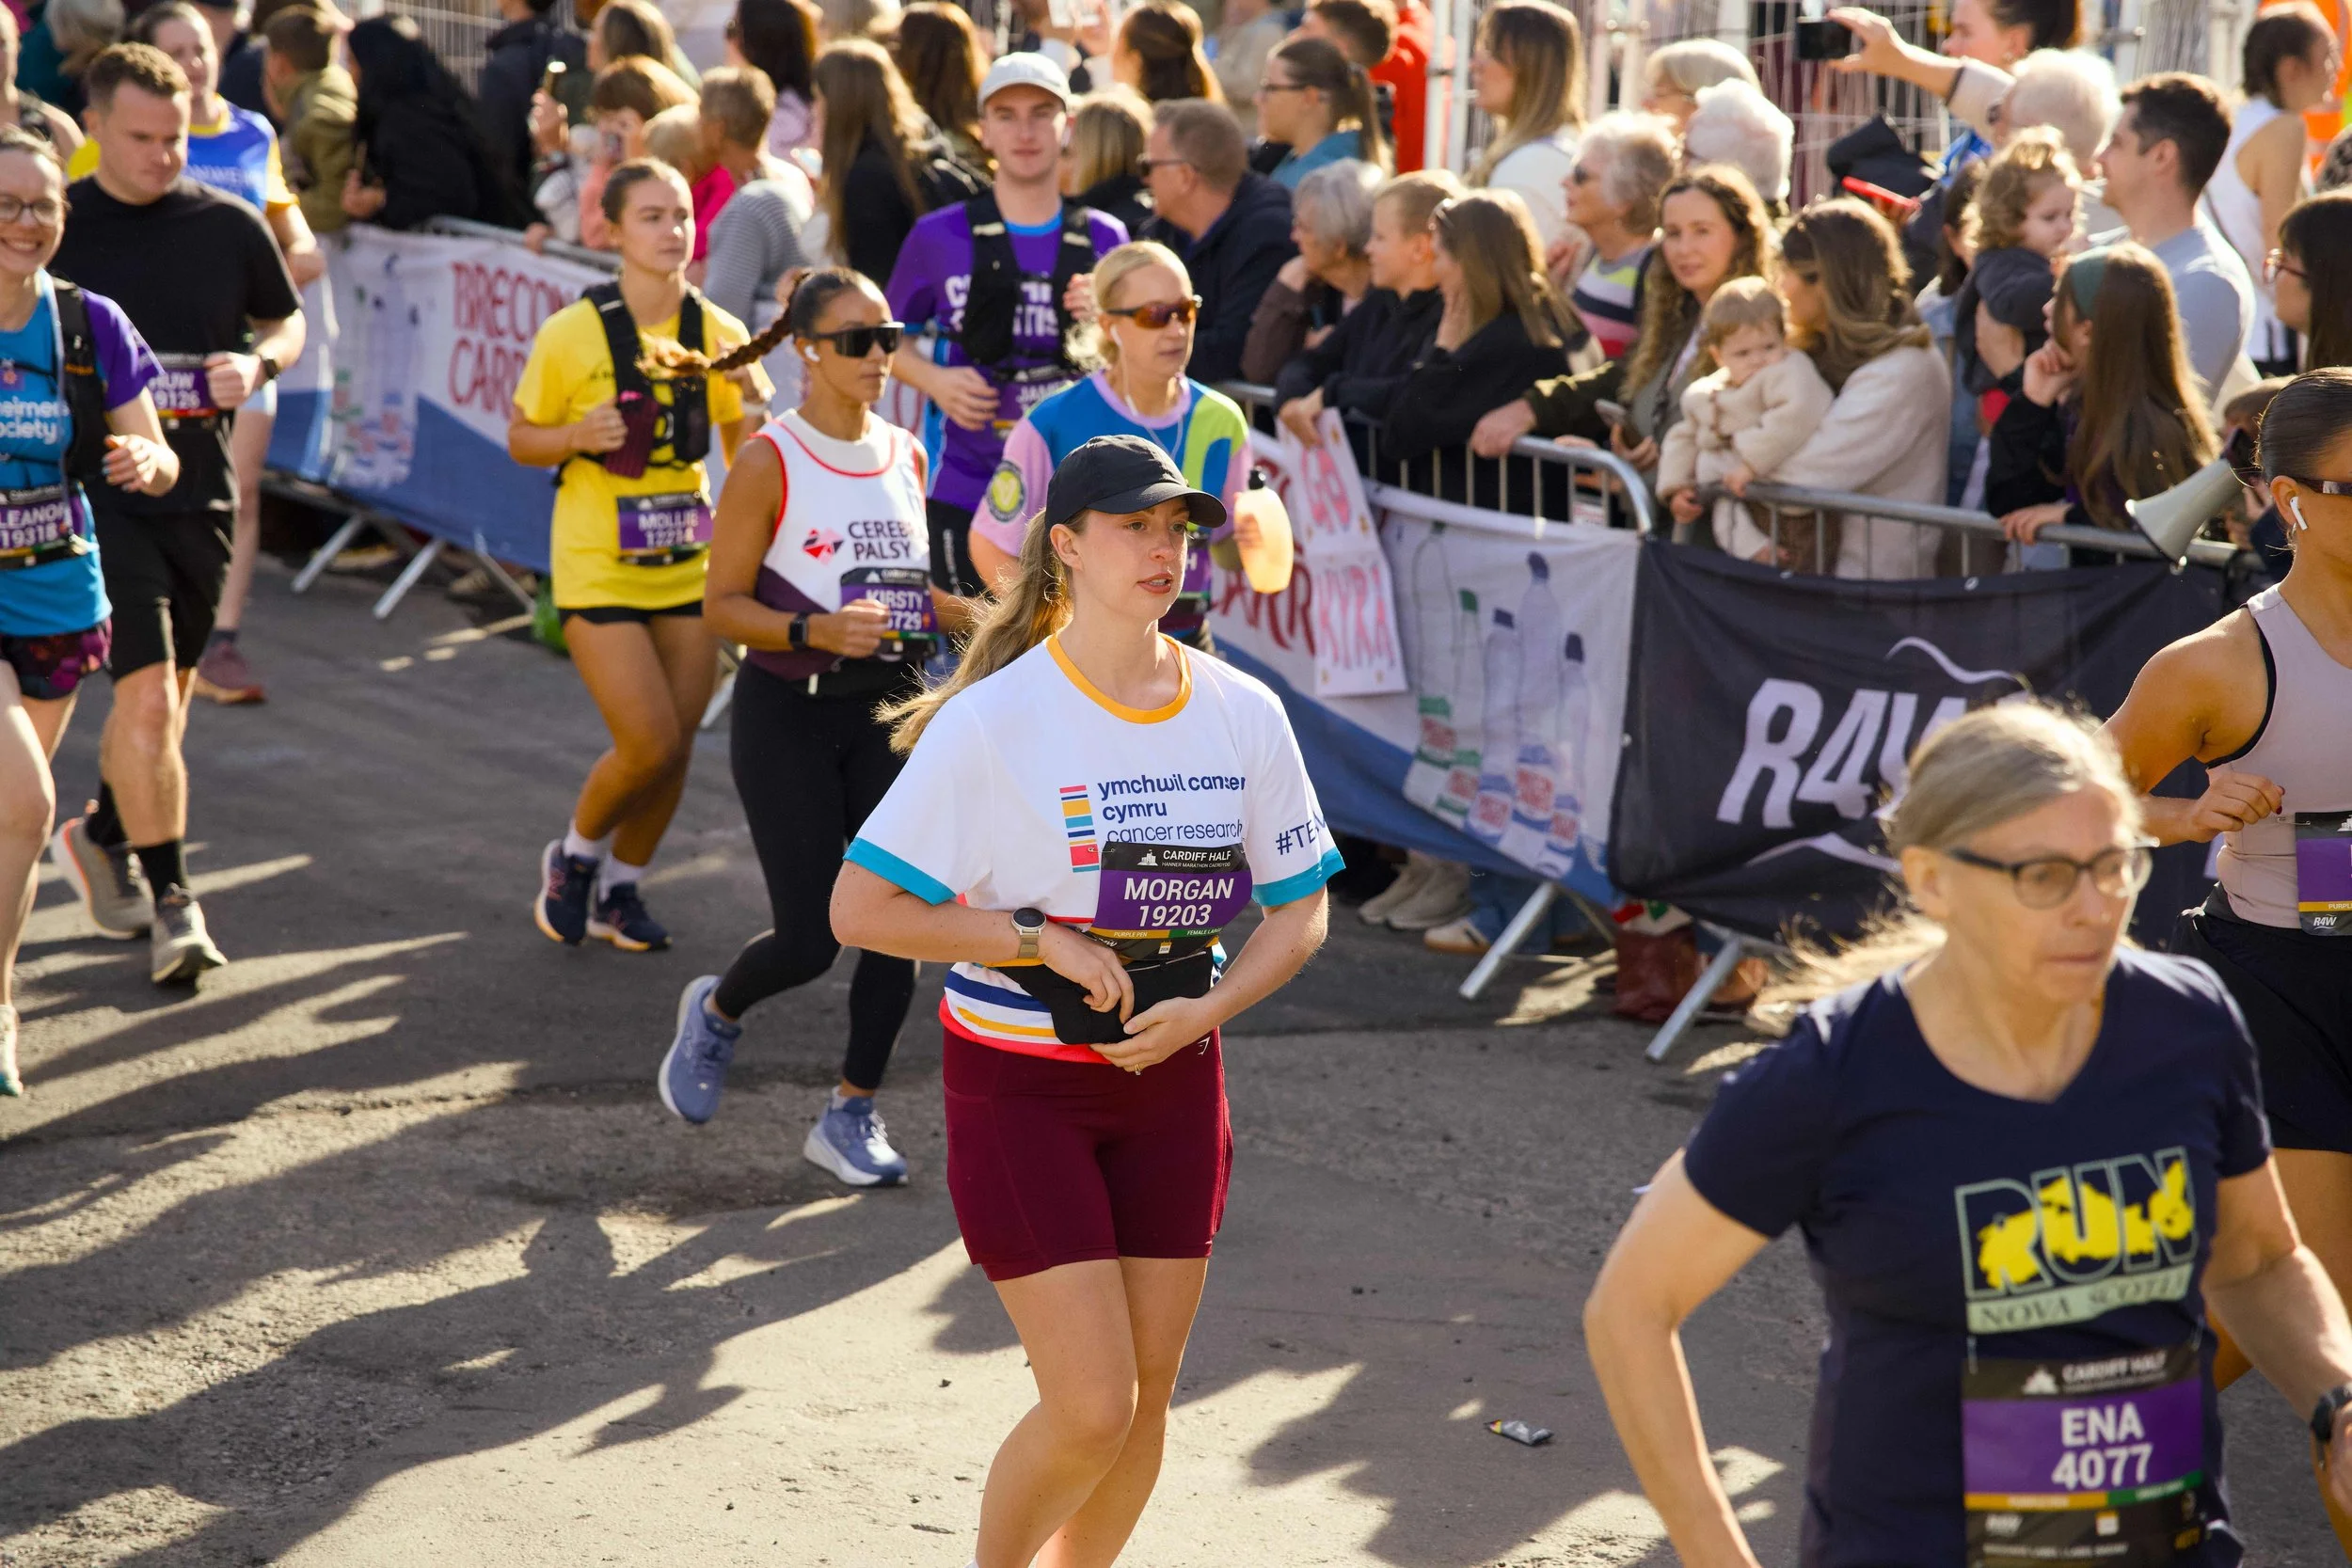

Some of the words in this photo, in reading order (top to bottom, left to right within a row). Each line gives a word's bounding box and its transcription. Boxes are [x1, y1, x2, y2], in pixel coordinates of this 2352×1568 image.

[638, 509, 699, 532] MOLLIE
[848, 520, 914, 539] CEREB
[854, 542, 911, 561] PALSY
[866, 589, 923, 610] KIRSTY
[1097, 774, 1185, 800] ymchwil
[1103, 801, 1168, 823] cymru
[1106, 824, 1175, 843] cancer
[1176, 818, 1243, 839] research
[1163, 850, 1207, 861] CARDIFF
[1209, 850, 1232, 862] HALF
[1124, 878, 1234, 901] MORGAN
[1139, 904, 1213, 927] 19203
[2312, 916, 2338, 927] R4W
[1954, 1147, 2200, 1302] RUN
[1980, 1296, 2072, 1325] NOVA
[2060, 1402, 2145, 1448] ENA
[2050, 1442, 2153, 1492] 4077
